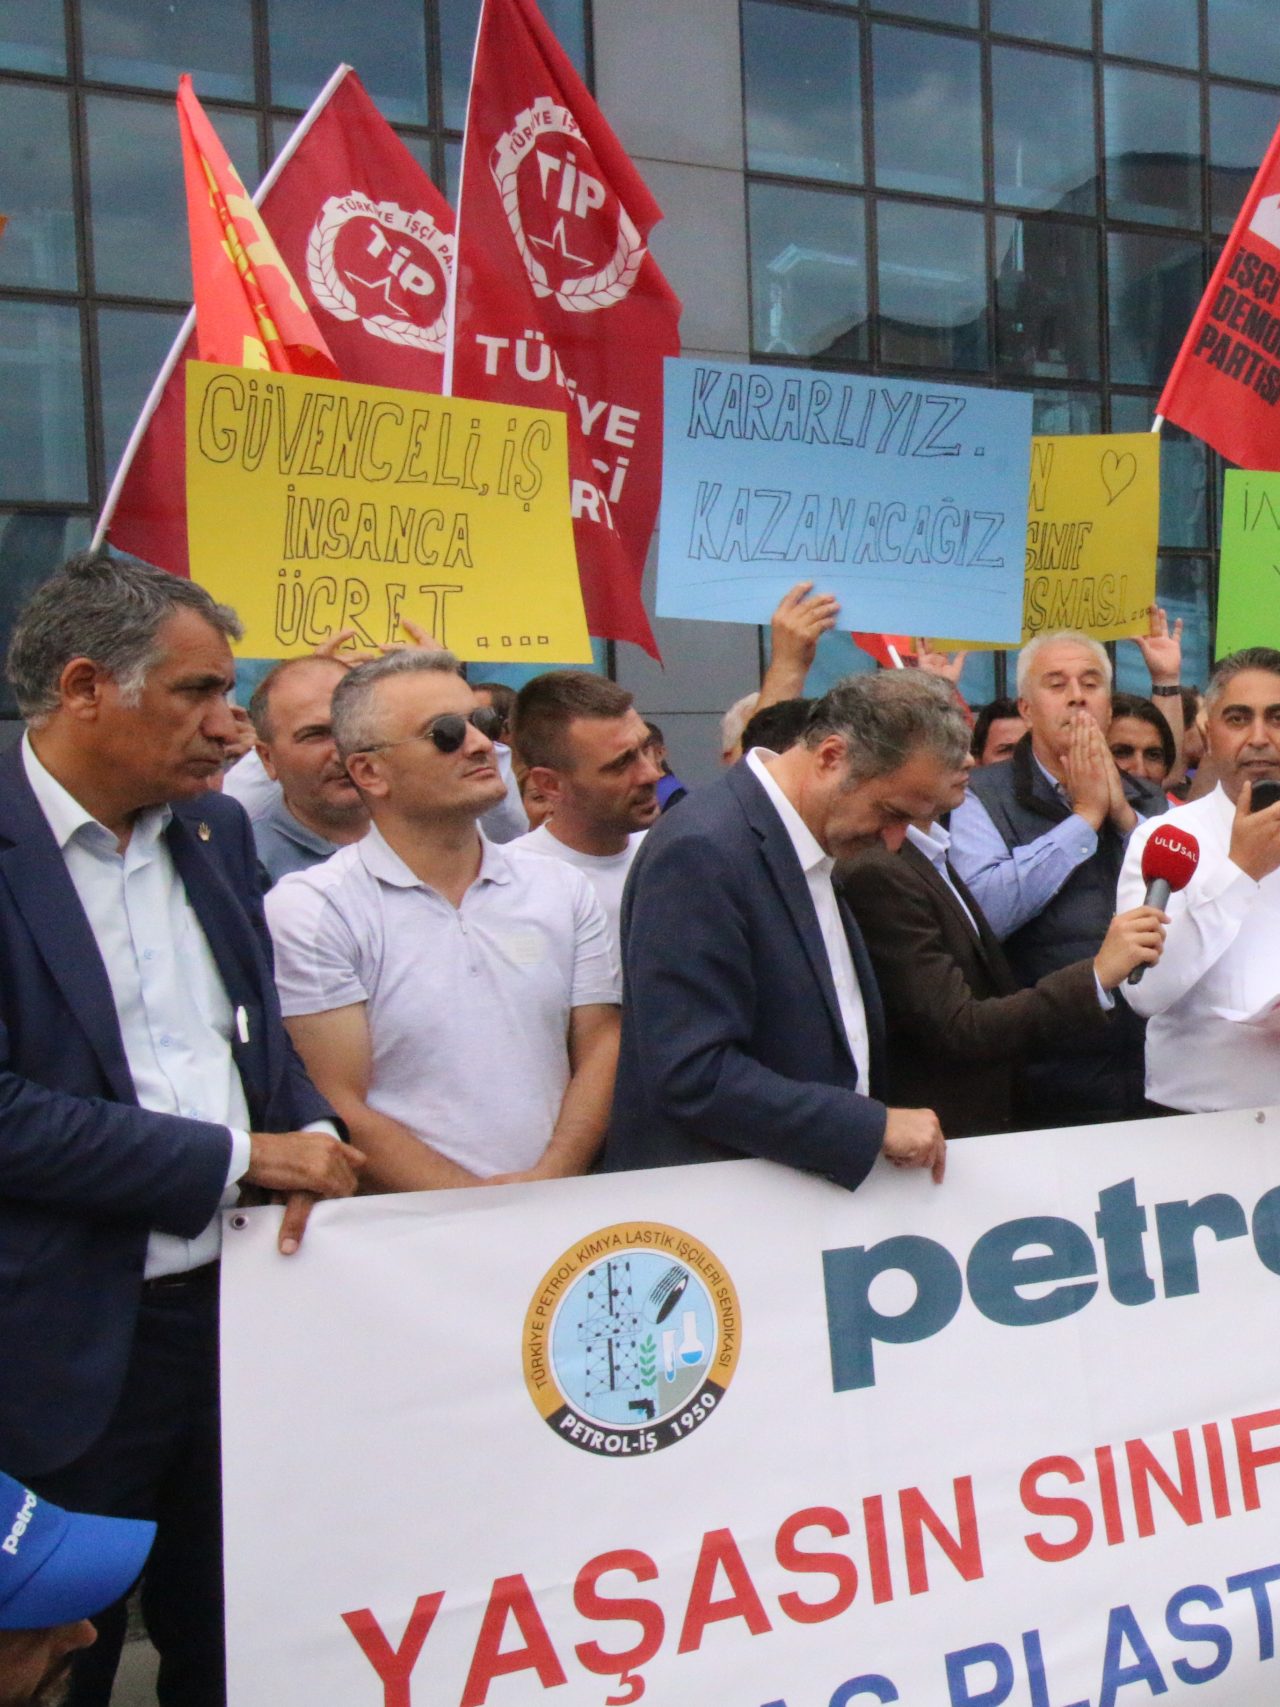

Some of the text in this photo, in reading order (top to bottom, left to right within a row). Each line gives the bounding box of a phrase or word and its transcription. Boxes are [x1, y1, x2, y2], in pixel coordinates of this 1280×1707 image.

[536, 149, 606, 219] TİP
[366, 223, 436, 297] TİP
[283, 483, 474, 568] İNSANCA
[687, 480, 1006, 568] KAZANACAĞIZ
[1154, 836, 1197, 863] ULUSAL
[537, 1261, 577, 1317] PETROL
[576, 1233, 622, 1264] KİMYA
[626, 1230, 675, 1249] LASTİK
[559, 1392, 717, 1453] PETROL-İŞ 1950
[339, 1474, 986, 1707] YAŞASIN
